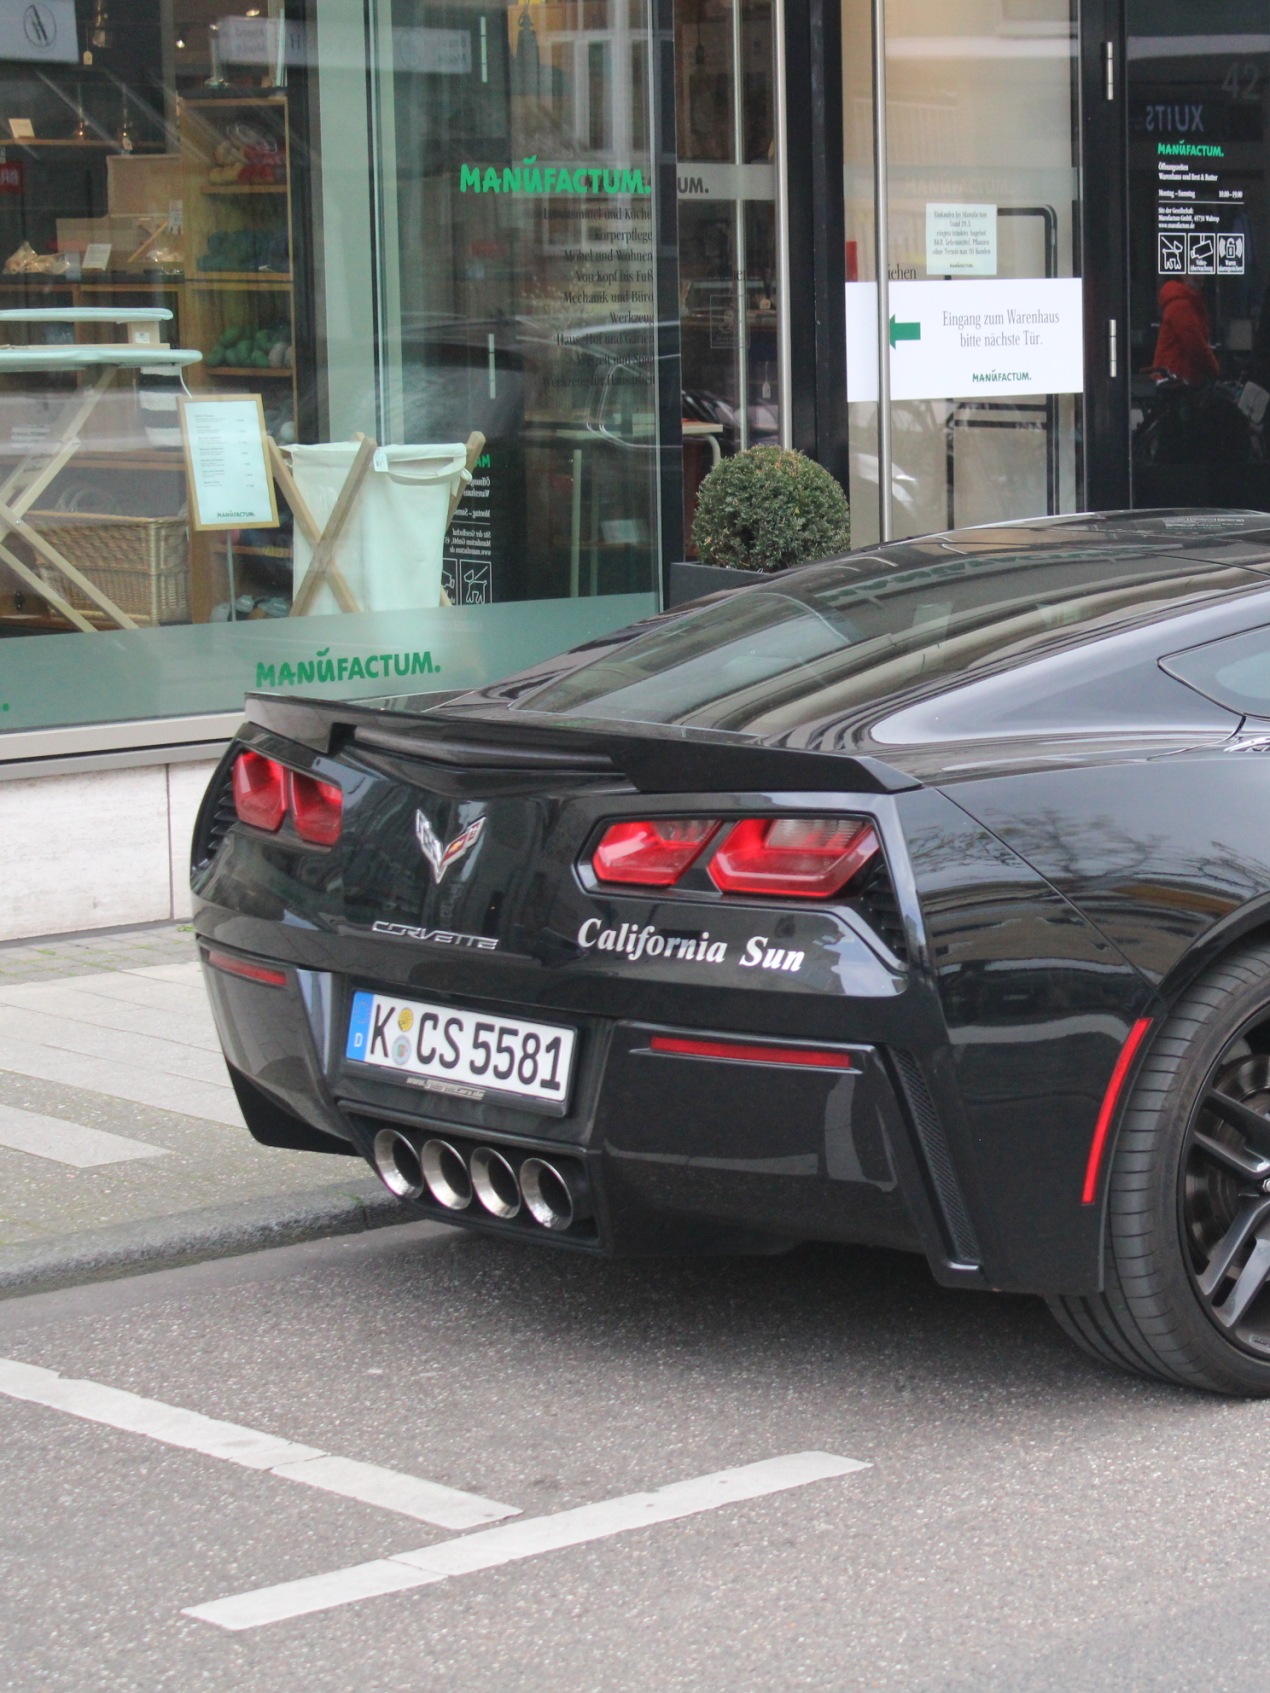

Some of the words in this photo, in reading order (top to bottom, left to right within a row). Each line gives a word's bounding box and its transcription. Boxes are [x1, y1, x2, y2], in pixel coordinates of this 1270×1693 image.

[1221, 62, 1259, 100] 42
[1158, 189, 1174, 198] Montag
[1178, 190, 1195, 199] Samstag
[616, 249, 653, 261] Wohnen
[886, 262, 917, 281] iehen
[564, 290, 609, 303] Mechanik
[610, 291, 629, 303] und
[943, 310, 981, 329] Eingang
[984, 314, 1004, 324] zum
[1007, 309, 1060, 324] Warenhaus
[960, 332, 981, 347] bitte
[984, 333, 1020, 347] nächste
[1023, 330, 1043, 346] Tür.
[369, 918, 500, 951] CORVETTE
[577, 917, 728, 963] California
[738, 935, 805, 972] Sun
[353, 1033, 363, 1048] D
[371, 1003, 395, 1059] K
[416, 1011, 465, 1071] CS
[469, 1021, 562, 1091] 5581
